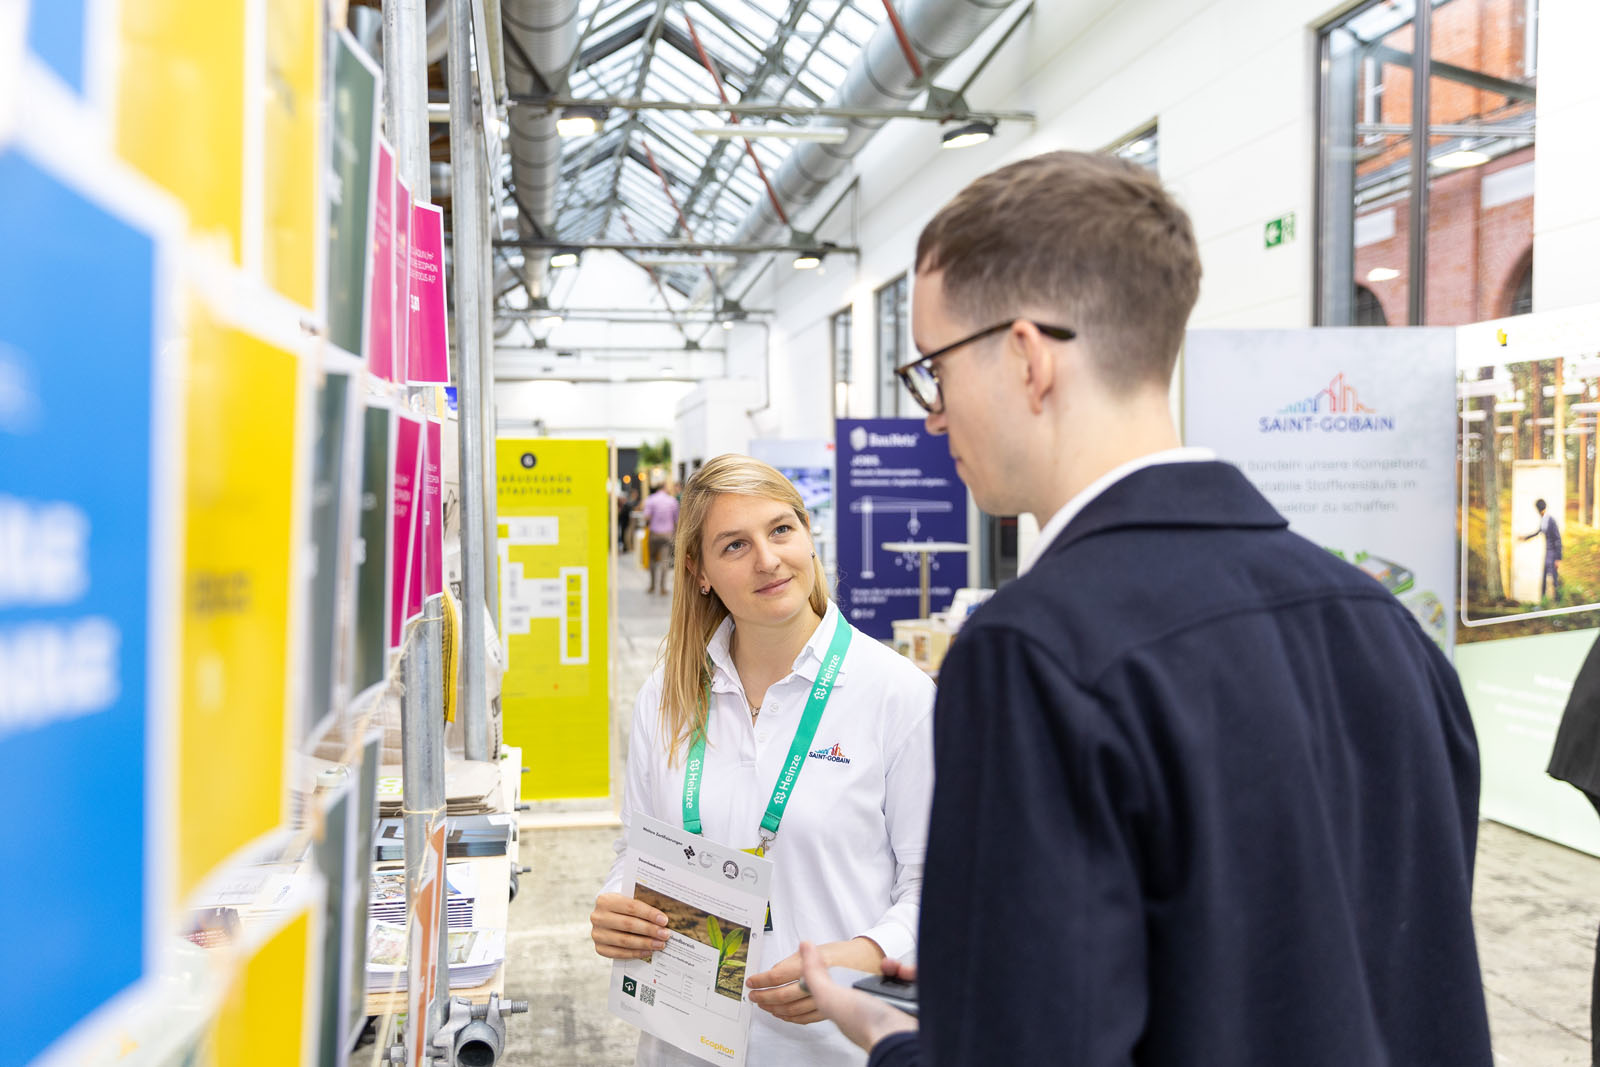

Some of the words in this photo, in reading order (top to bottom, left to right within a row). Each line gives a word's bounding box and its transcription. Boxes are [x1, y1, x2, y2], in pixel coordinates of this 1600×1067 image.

[1258, 416, 1396, 433] SAINT-GOBAIN
[819, 654, 840, 688] Heinze
[808, 751, 851, 765] SAINT-GOBAIN
[779, 754, 802, 791] Heinze
[686, 772, 699, 809] Heinze
[700, 1035, 735, 1056] Ecophon
